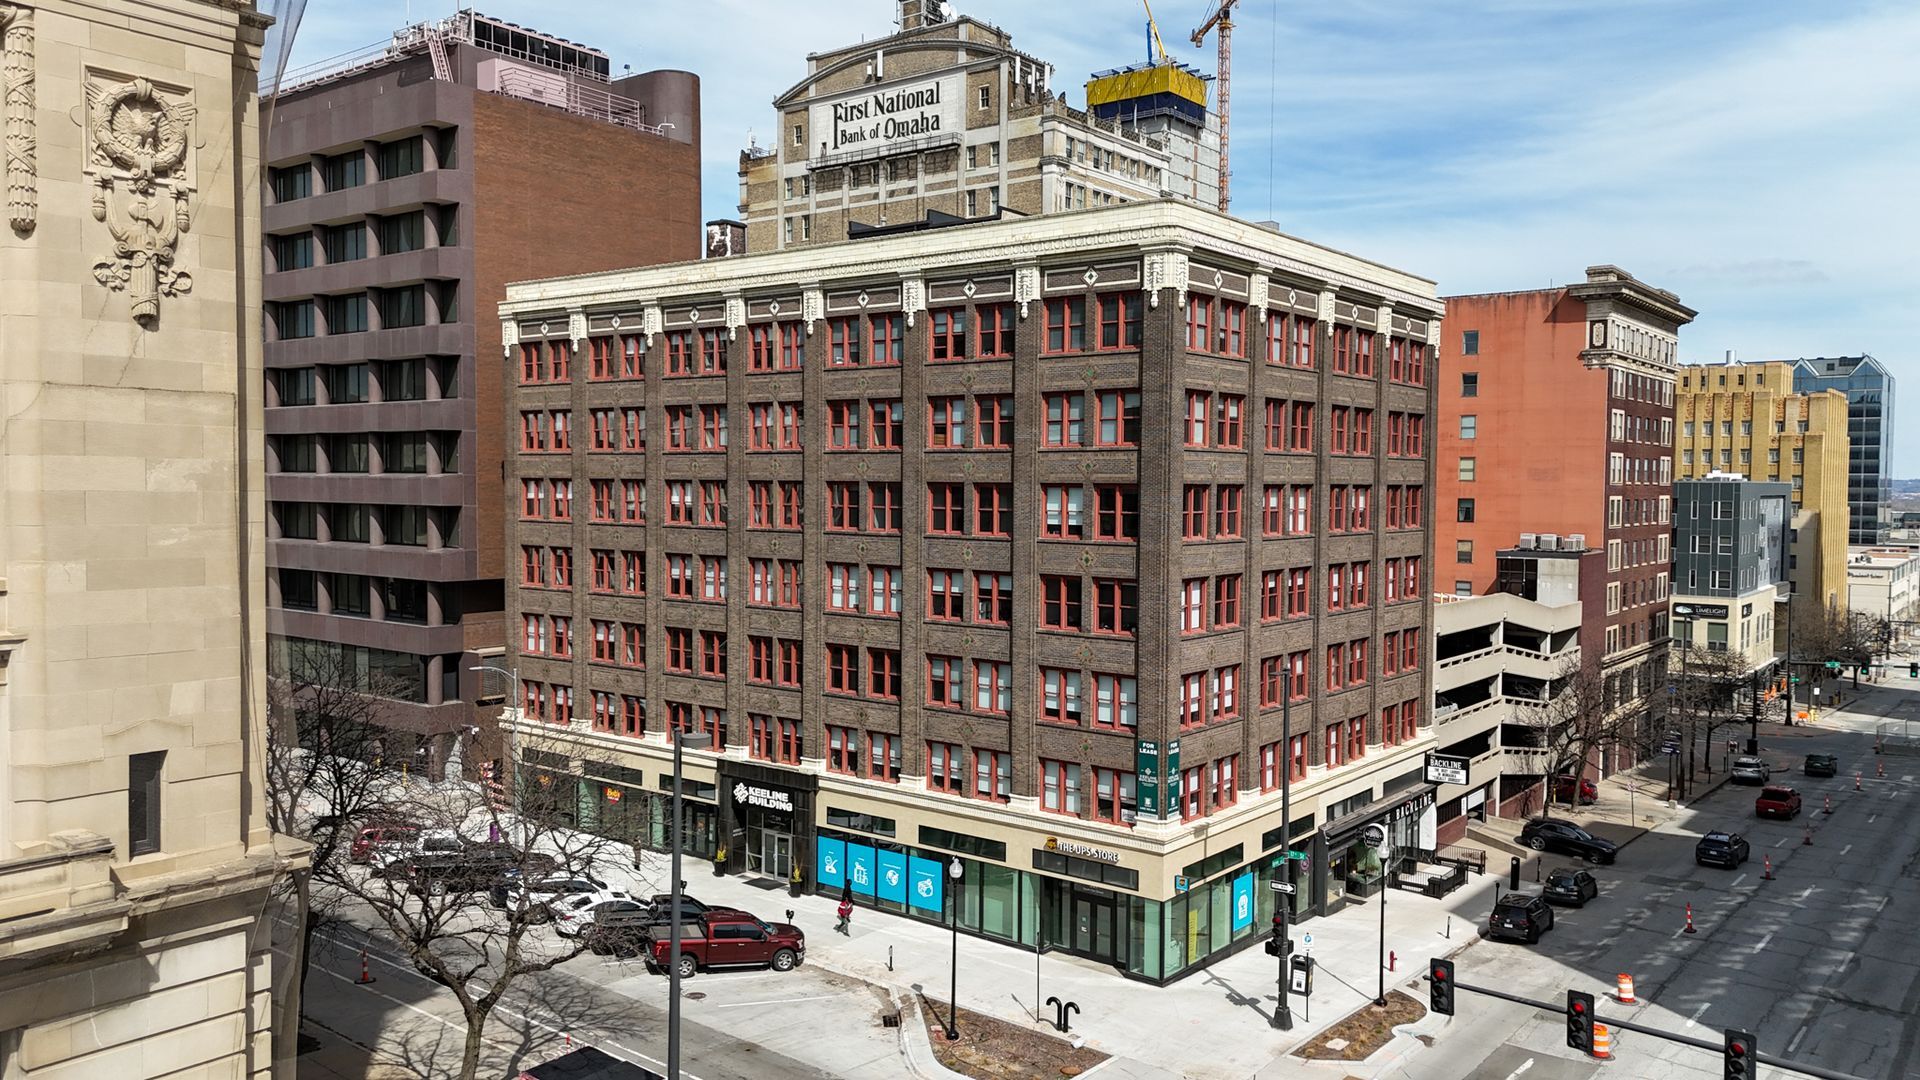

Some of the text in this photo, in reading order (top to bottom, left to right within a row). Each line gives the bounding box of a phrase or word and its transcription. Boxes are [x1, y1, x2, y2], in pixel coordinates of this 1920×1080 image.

[831, 81, 941, 150] First National
[840, 111, 941, 146] Bank of Omaha
[1430, 758, 1462, 770] BACKLINE
[748, 785, 789, 802] KEELINE
[748, 795, 793, 812] BUILDING
[1395, 793, 1432, 820] BACKLINE
[1059, 842, 1074, 853] THE
[1075, 844, 1091, 857] UPS
[1092, 848, 1119, 862] STORE
